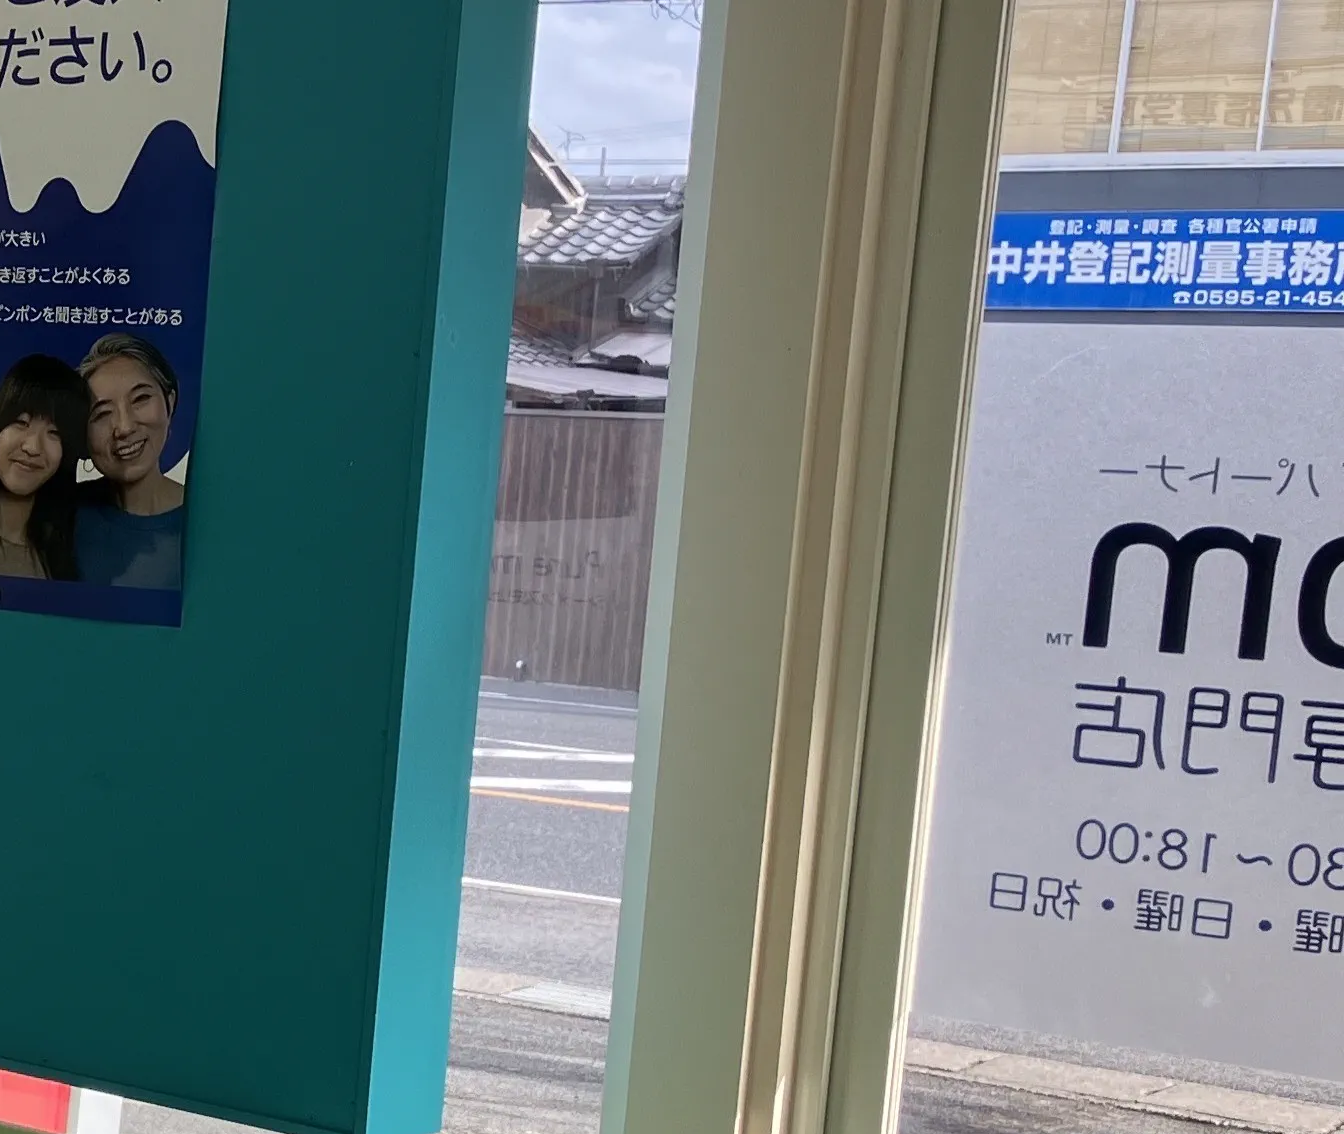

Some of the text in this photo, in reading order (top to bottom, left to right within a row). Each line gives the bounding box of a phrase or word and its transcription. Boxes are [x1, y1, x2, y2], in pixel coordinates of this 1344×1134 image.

[1049, 217, 1318, 236] 登記・測量・調査 各種官公署申請
[987, 240, 1344, 286] 中井登記測量事務
